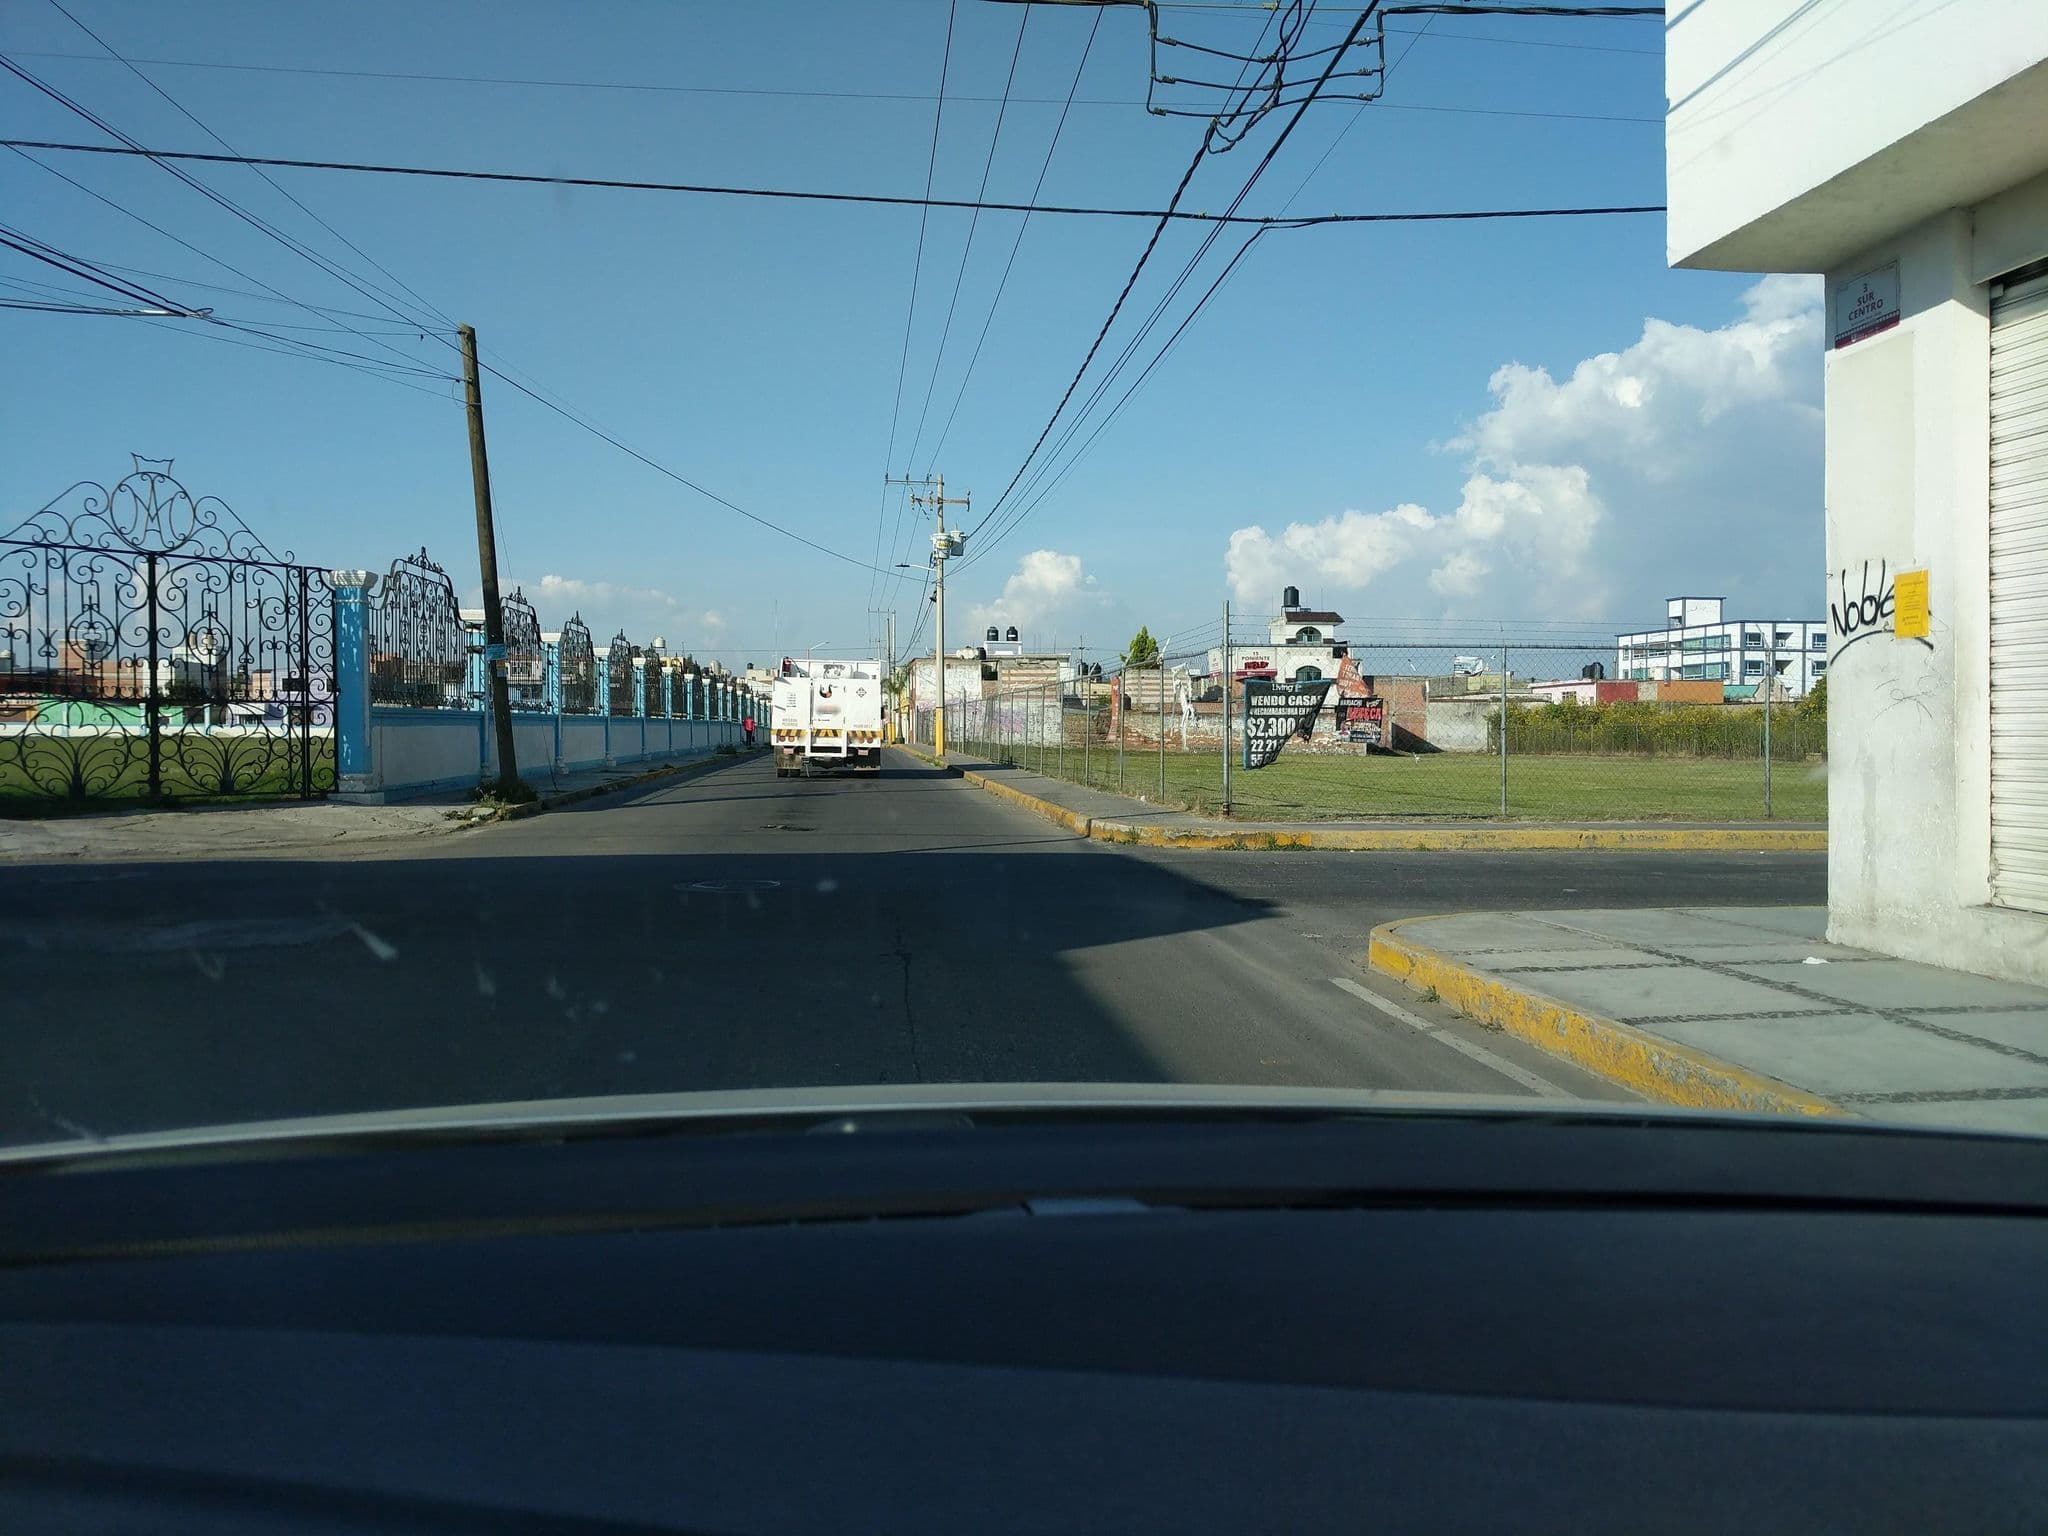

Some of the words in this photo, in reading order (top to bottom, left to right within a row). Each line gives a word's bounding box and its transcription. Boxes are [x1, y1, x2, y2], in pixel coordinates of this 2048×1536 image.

[1857, 291, 1875, 307] SUR
[1848, 299, 1884, 321] CENTRO
[1272, 683, 1294, 693] Living
[1251, 695, 1286, 706] VENDO
[1251, 739, 1264, 752] 22
